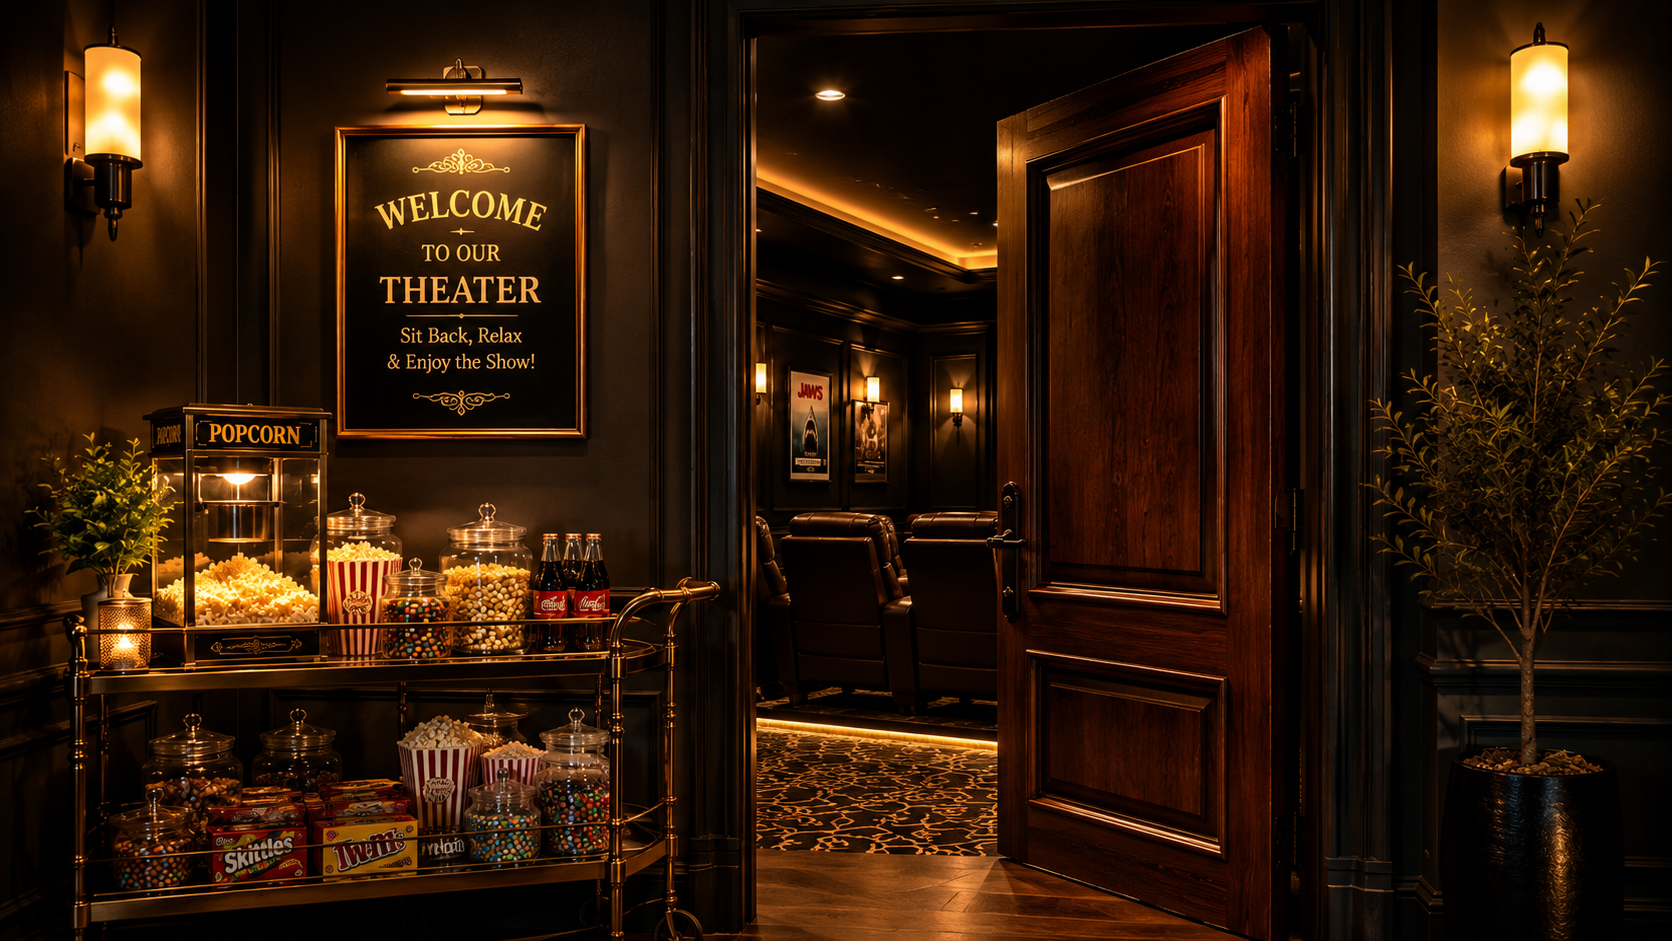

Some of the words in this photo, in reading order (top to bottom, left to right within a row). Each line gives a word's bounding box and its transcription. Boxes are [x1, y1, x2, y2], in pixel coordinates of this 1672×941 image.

[374, 189, 548, 231] WELCOME
[421, 244, 449, 262] TO
[456, 244, 501, 262] OUR
[379, 276, 542, 304] THEATER
[400, 327, 423, 344] Sit
[428, 326, 473, 346] Back,
[478, 327, 522, 344] Relax
[387, 354, 400, 370] &
[406, 353, 451, 374] Enjoy
[455, 353, 481, 370] the
[486, 353, 536, 370] Show!
[797, 382, 824, 401] JAWS
[208, 423, 301, 445] POPCORN
[224, 836, 294, 874] Skittles
